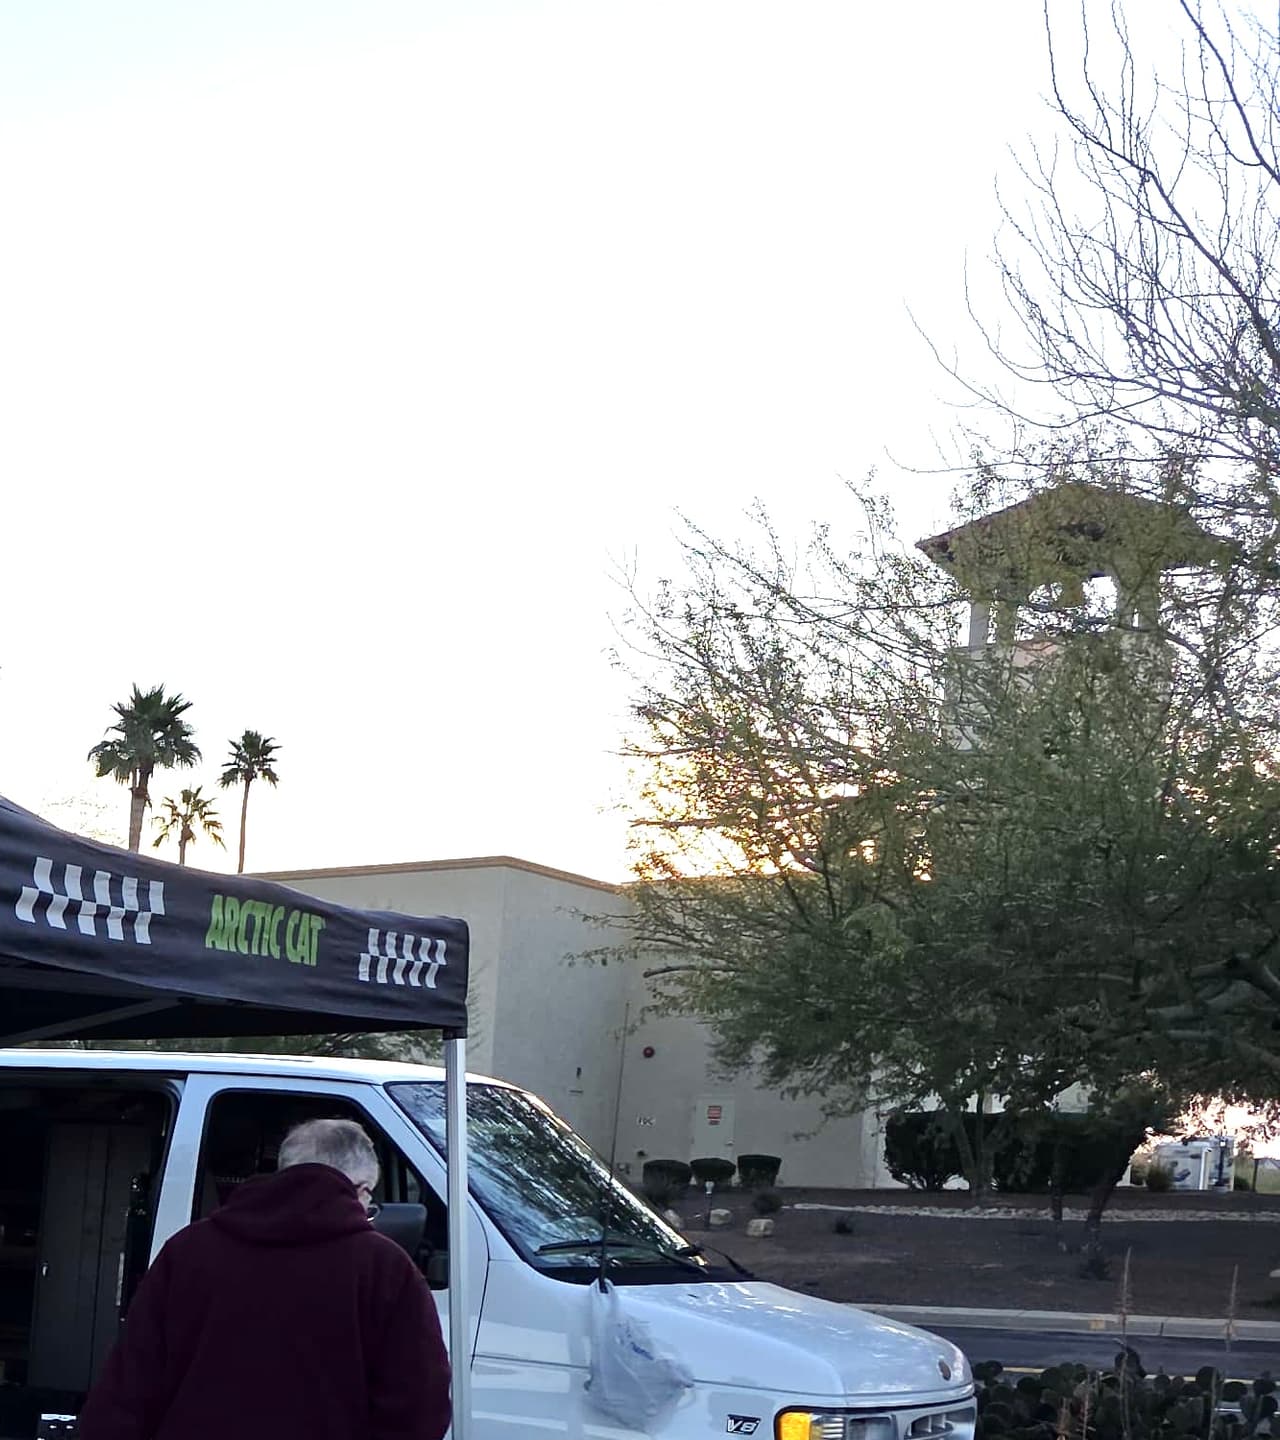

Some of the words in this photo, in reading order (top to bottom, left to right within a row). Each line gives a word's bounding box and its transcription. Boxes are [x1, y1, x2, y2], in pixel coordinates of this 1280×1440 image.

[205, 895, 285, 960] ARCTIC
[285, 910, 326, 966] CAT
[728, 1419, 757, 1432] V8
